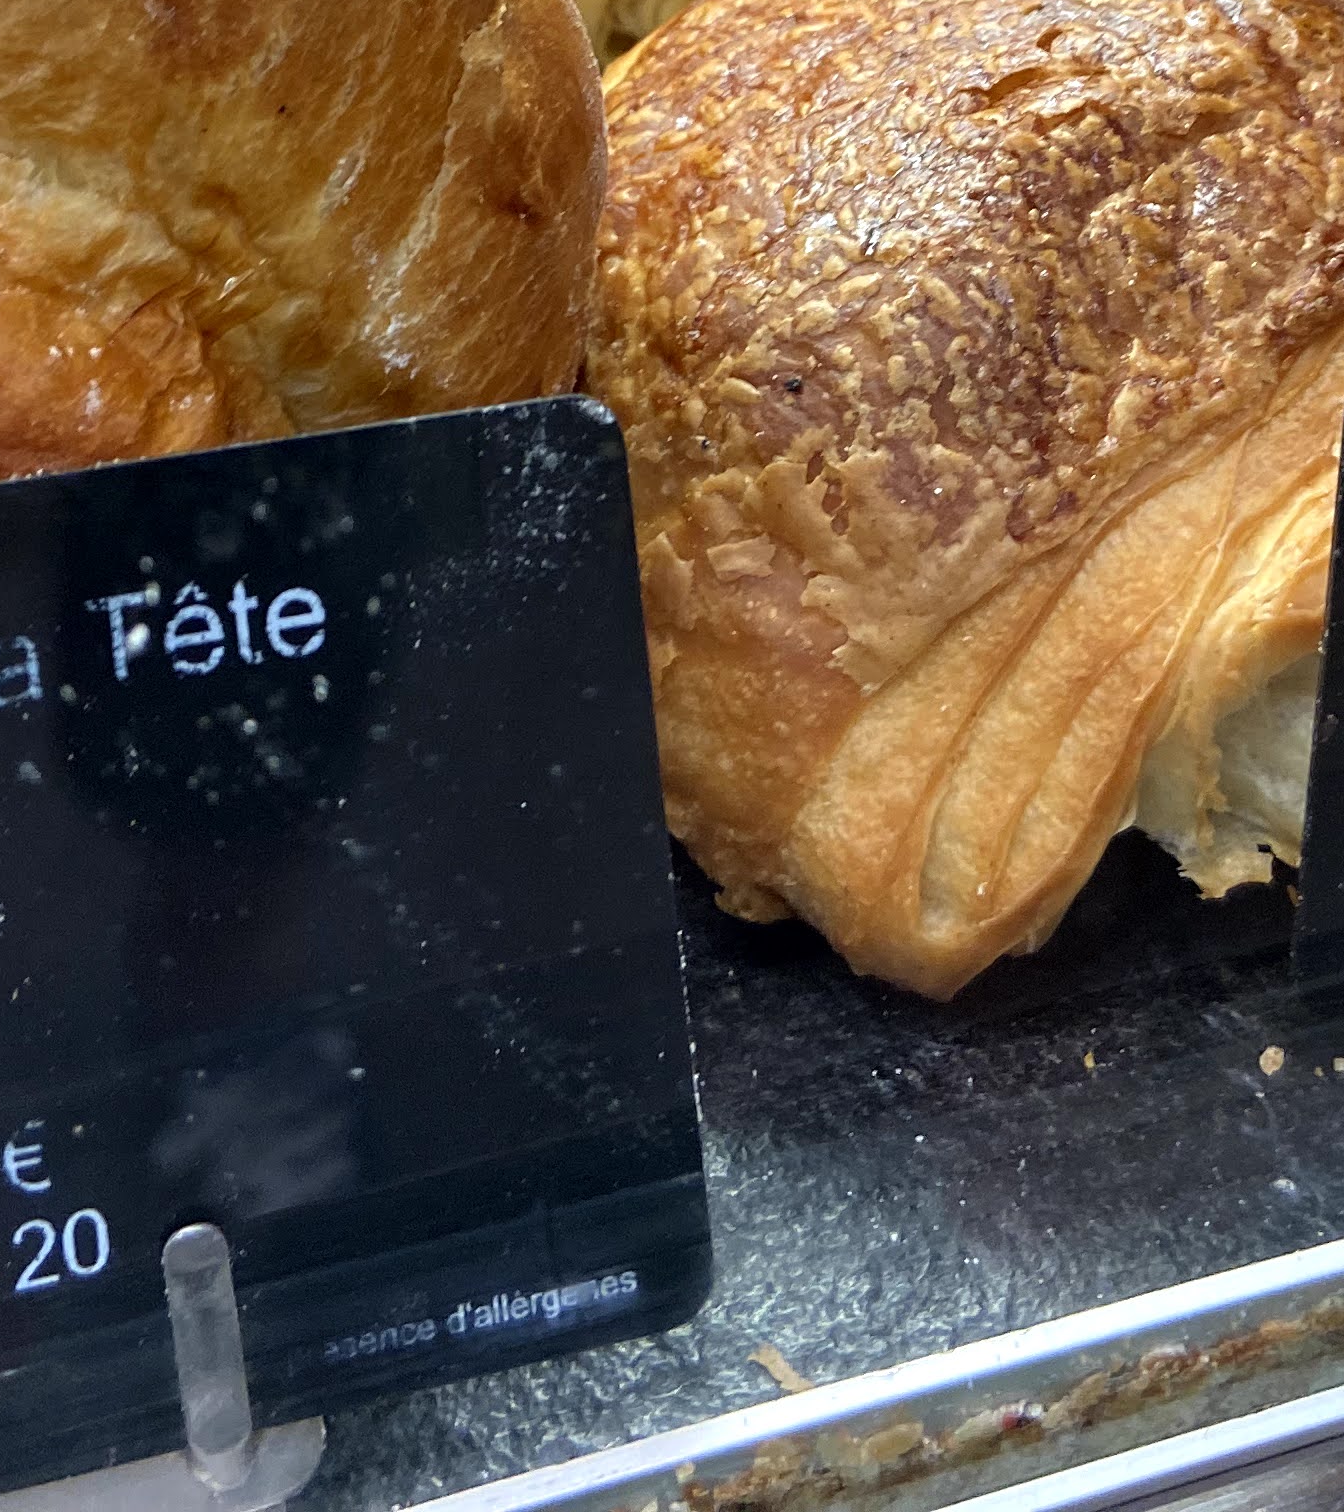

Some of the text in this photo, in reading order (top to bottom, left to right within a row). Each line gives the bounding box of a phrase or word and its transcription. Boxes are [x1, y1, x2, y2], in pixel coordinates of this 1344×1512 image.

[86, 580, 327, 679] Tête
[3, 1120, 52, 1191] €
[12, 1207, 110, 1290] 20
